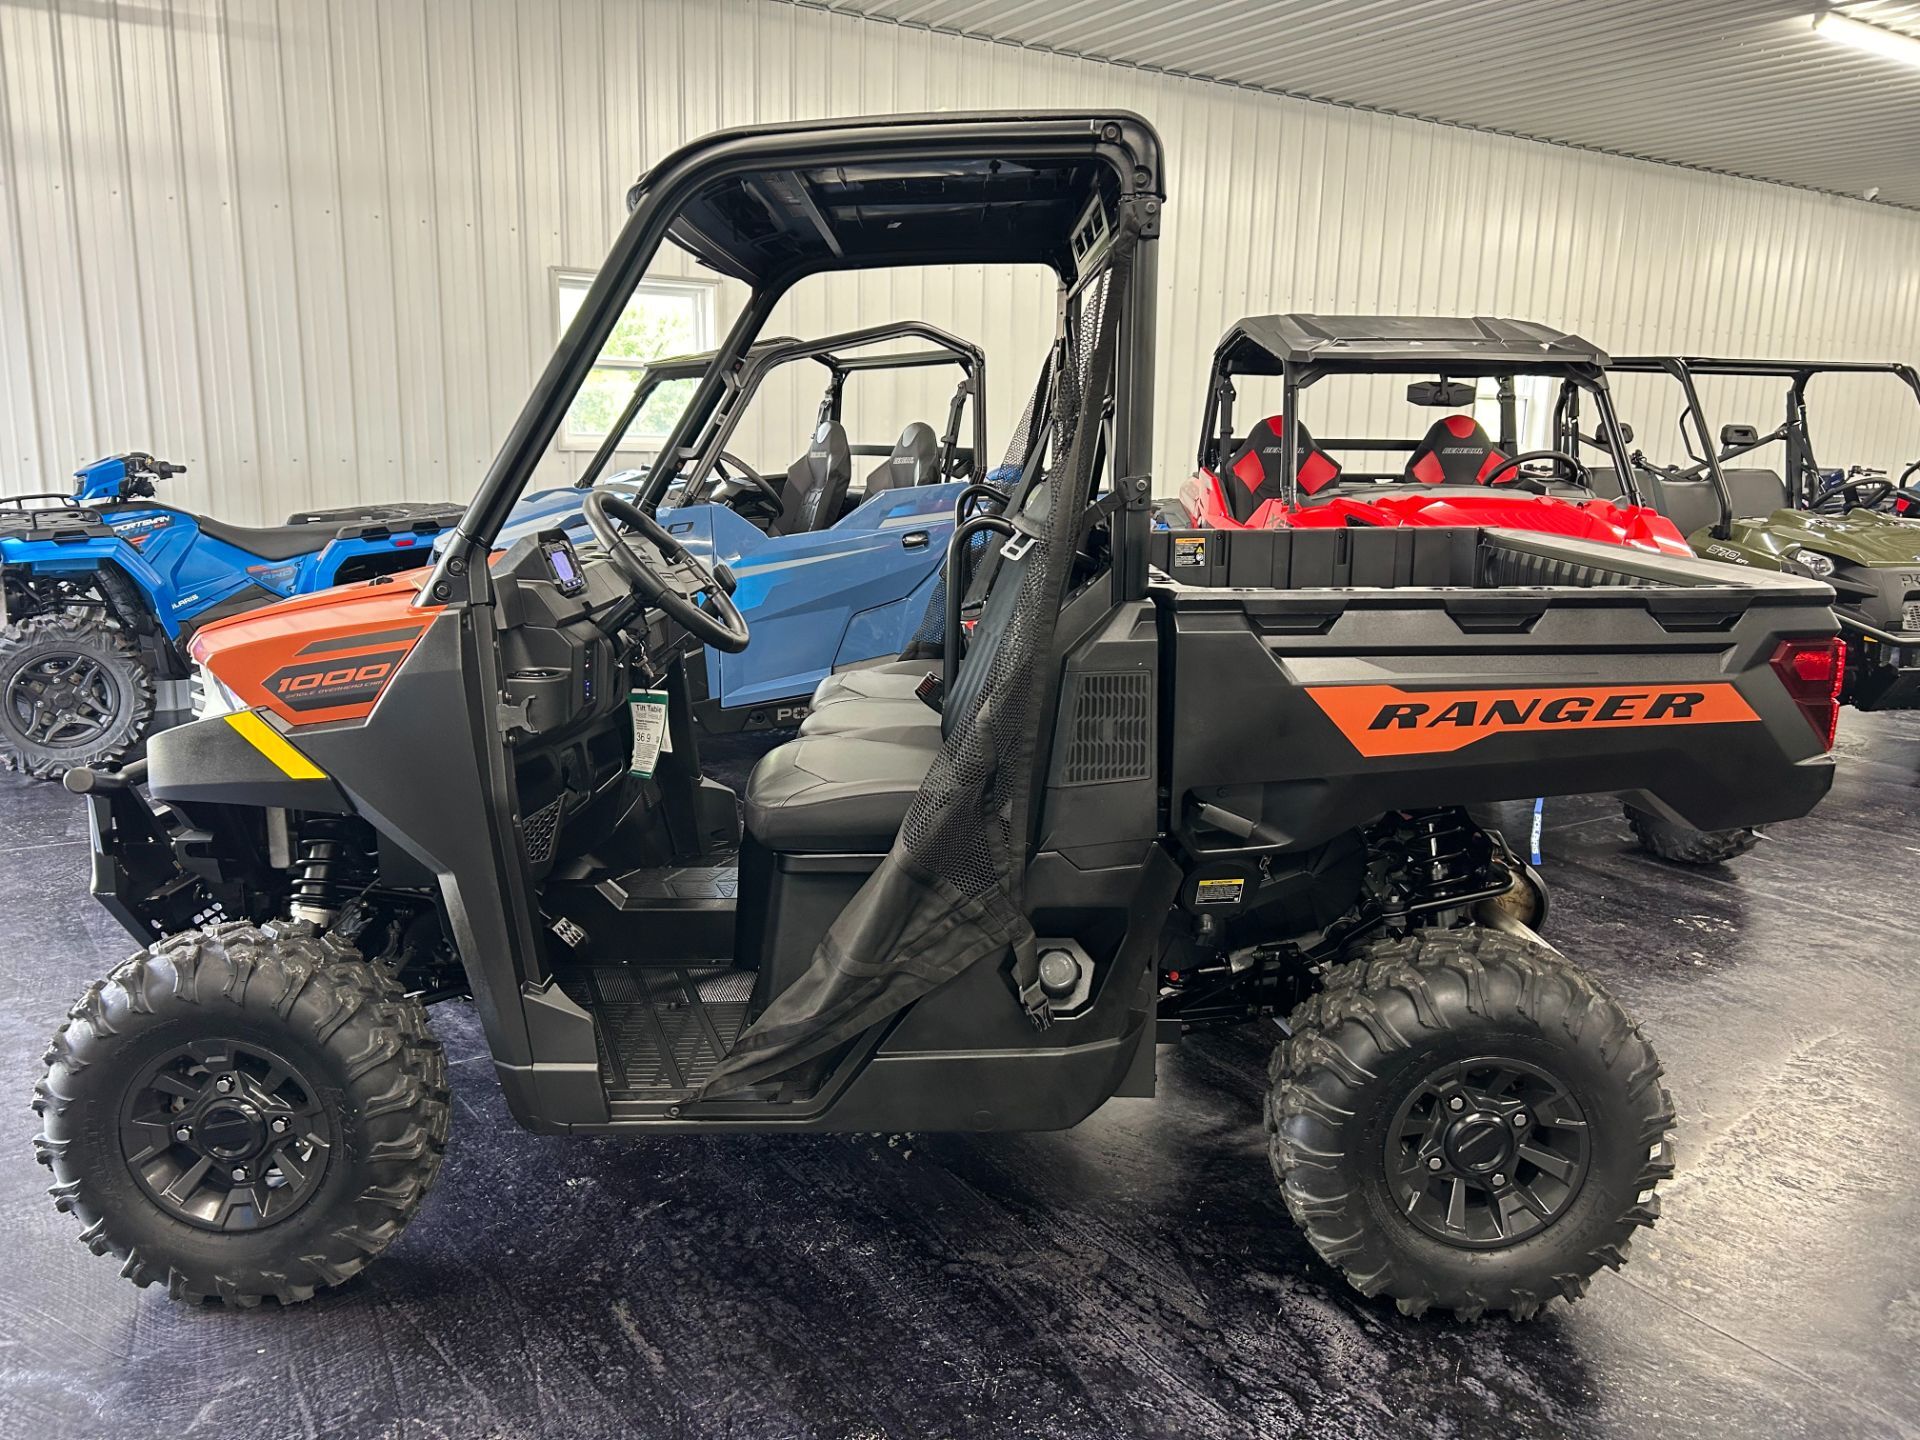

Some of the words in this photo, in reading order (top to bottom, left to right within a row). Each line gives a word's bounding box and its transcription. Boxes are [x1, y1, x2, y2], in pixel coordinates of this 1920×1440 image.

[1706, 544, 1741, 560] 570
[278, 663, 391, 693] 1000
[1367, 692, 1705, 730] RANGER
